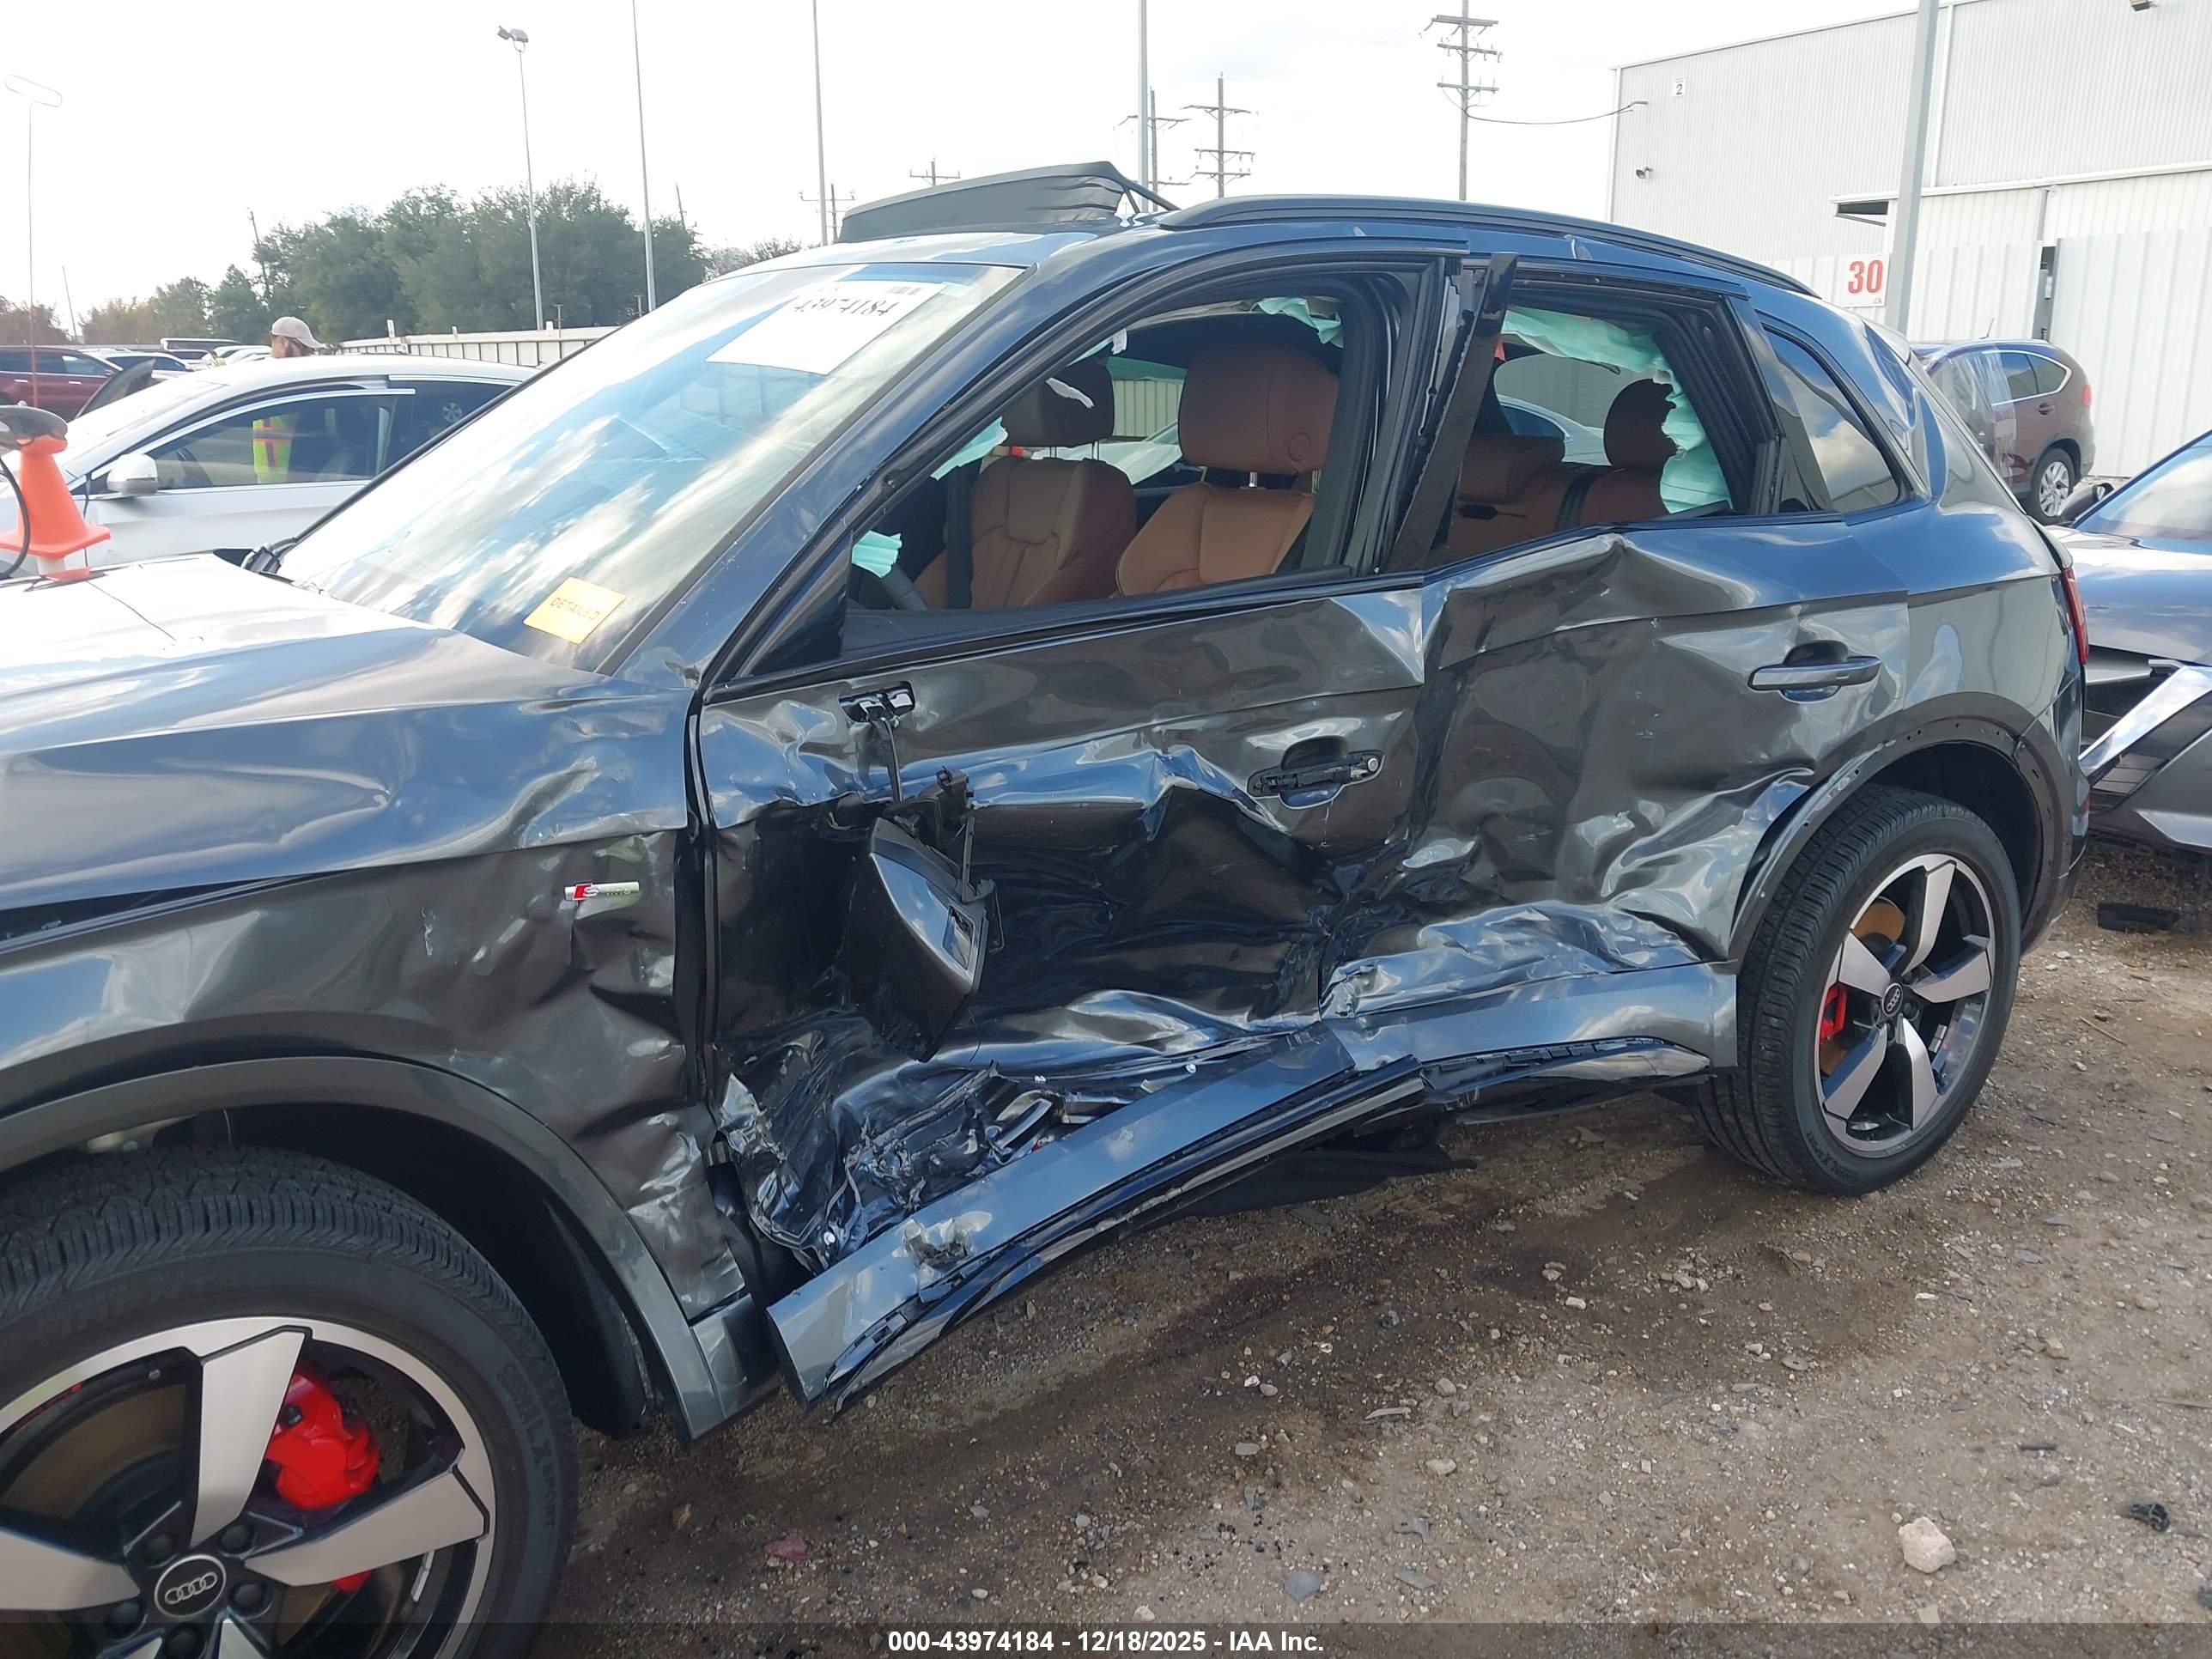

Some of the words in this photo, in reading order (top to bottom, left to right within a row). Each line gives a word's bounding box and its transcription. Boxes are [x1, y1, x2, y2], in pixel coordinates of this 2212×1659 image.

[1675, 83, 1683, 95] 2
[1848, 259, 1884, 294] 30
[550, 597, 600, 620] DETAILED
